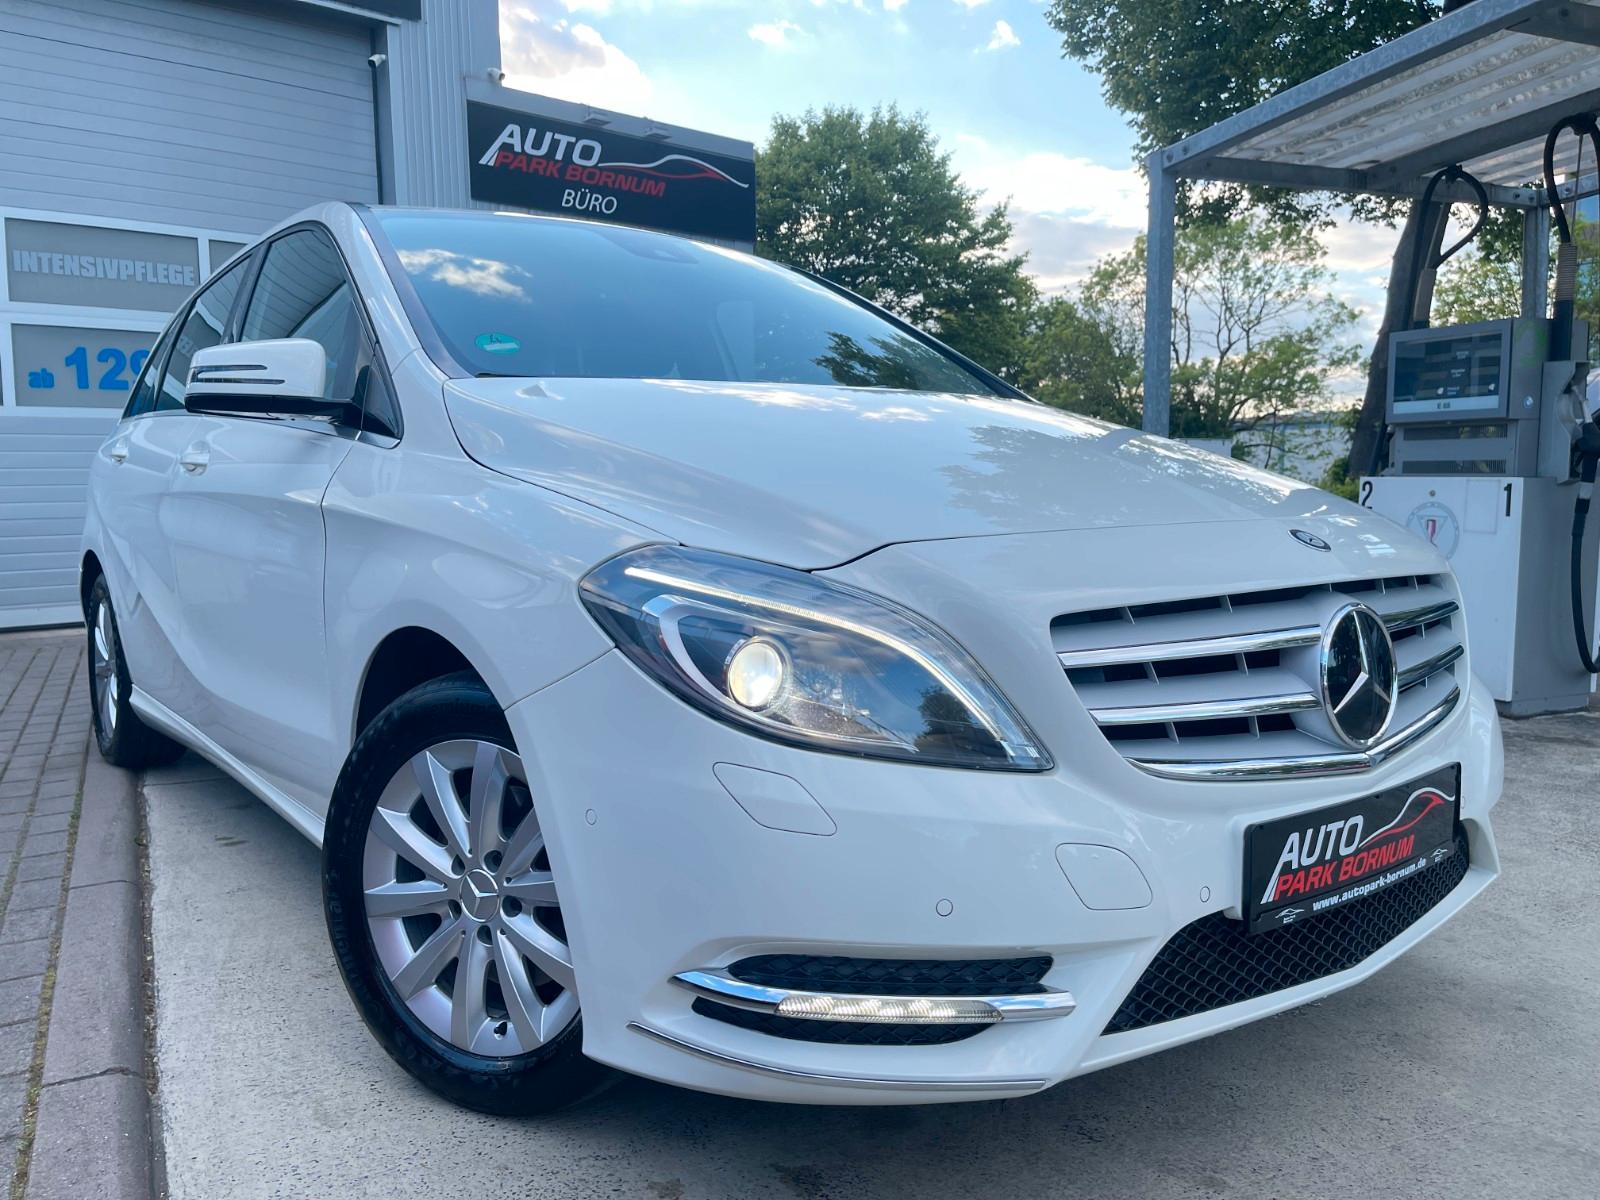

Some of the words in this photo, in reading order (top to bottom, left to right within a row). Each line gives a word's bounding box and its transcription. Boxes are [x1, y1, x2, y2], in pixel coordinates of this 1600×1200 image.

[479, 123, 601, 167] AUTO
[494, 150, 562, 178] PARK
[564, 164, 666, 198] BORNUM
[561, 188, 618, 214] BÜRO
[13, 250, 195, 287] INTENSIVPFLEGE
[28, 368, 55, 389] ab
[1362, 480, 1373, 510] 2
[1503, 482, 1513, 517] 1
[1260, 814, 1365, 905] AUTO
[1273, 860, 1337, 902] PARK
[1338, 834, 1415, 881] BORNUM
[1312, 857, 1427, 912] www.autopark-bornum.de
